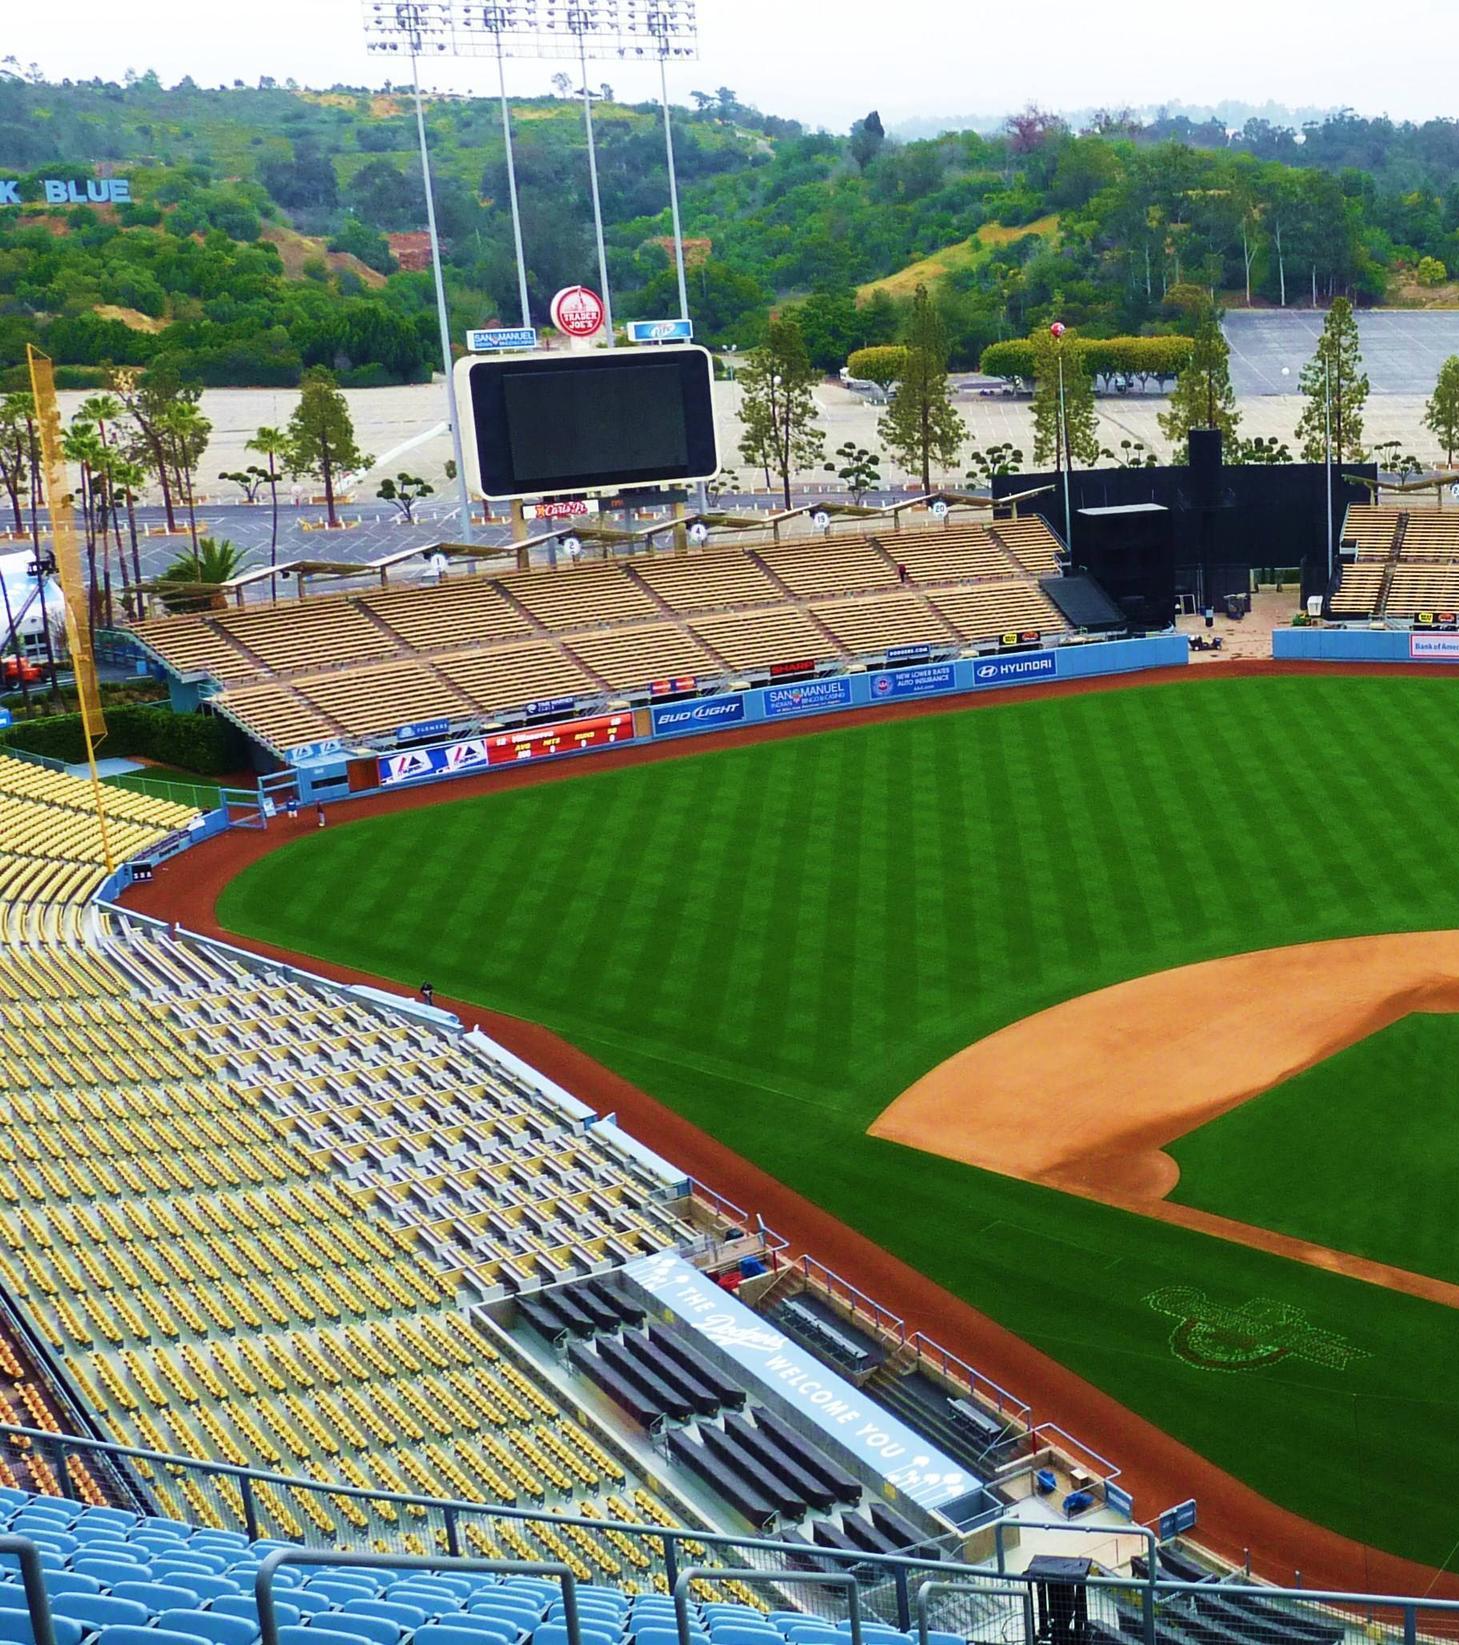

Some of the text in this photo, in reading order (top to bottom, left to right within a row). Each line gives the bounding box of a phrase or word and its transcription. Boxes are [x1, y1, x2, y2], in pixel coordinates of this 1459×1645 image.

[45, 179, 131, 203] BLUE
[563, 312, 598, 321] TRADER
[474, 331, 533, 341] SAN MANUEL
[771, 661, 813, 674] SHARP
[896, 667, 950, 680] NEW LOWER RATES
[1000, 659, 1051, 674] HYUNDAI
[897, 674, 949, 687] AUTO INSURANCE
[769, 681, 845, 702] SAN MANUEL
[658, 703, 740, 725] BUD LIGHT
[676, 1285, 905, 1459] THE Dodgers WELCOME YOU
